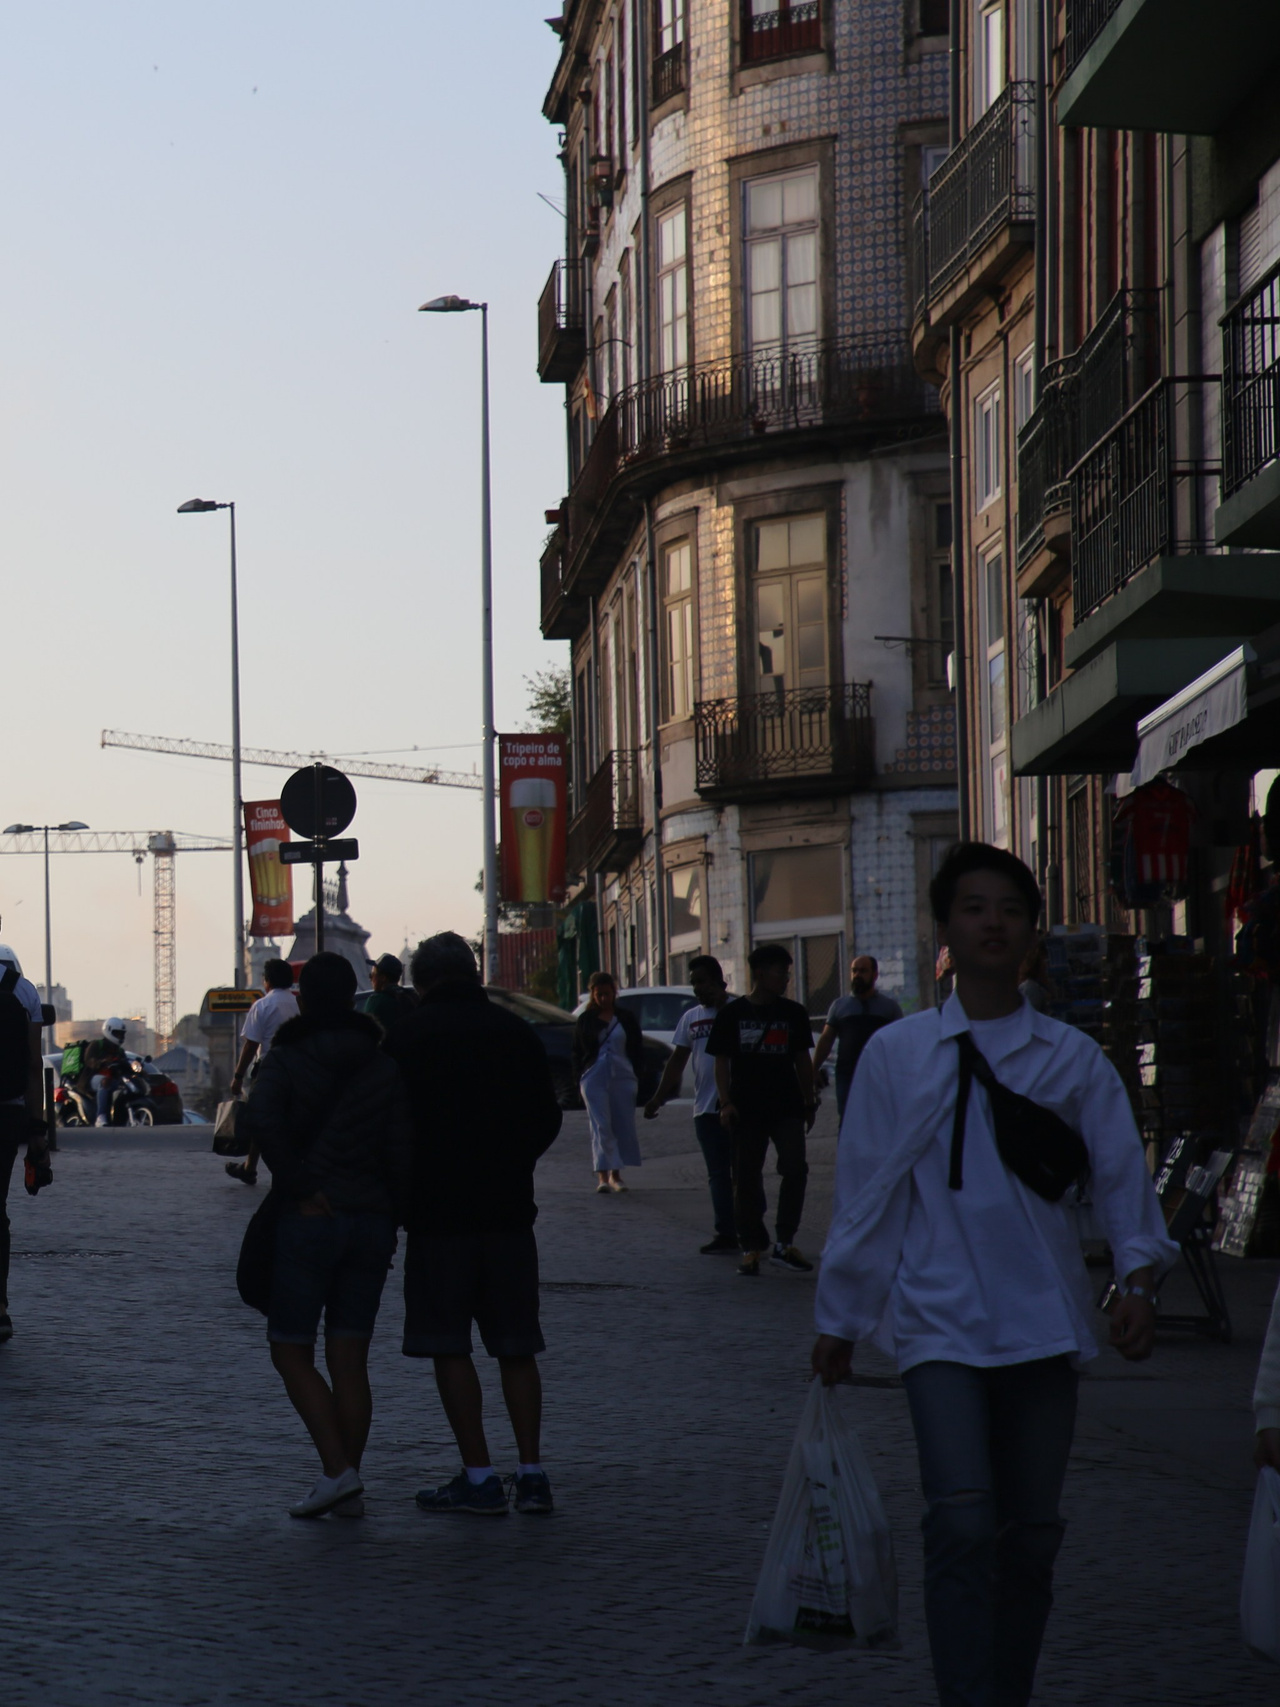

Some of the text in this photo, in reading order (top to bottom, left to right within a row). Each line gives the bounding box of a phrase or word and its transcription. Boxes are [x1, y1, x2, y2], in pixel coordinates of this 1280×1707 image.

[506, 742, 560, 756] Tripeiro de
[503, 754, 562, 769] copo e alma
[255, 806, 279, 819] Cinco
[250, 819, 285, 832] fininhos
[1153, 812, 1171, 847] 7
[741, 1021, 786, 1030] TOMMY
